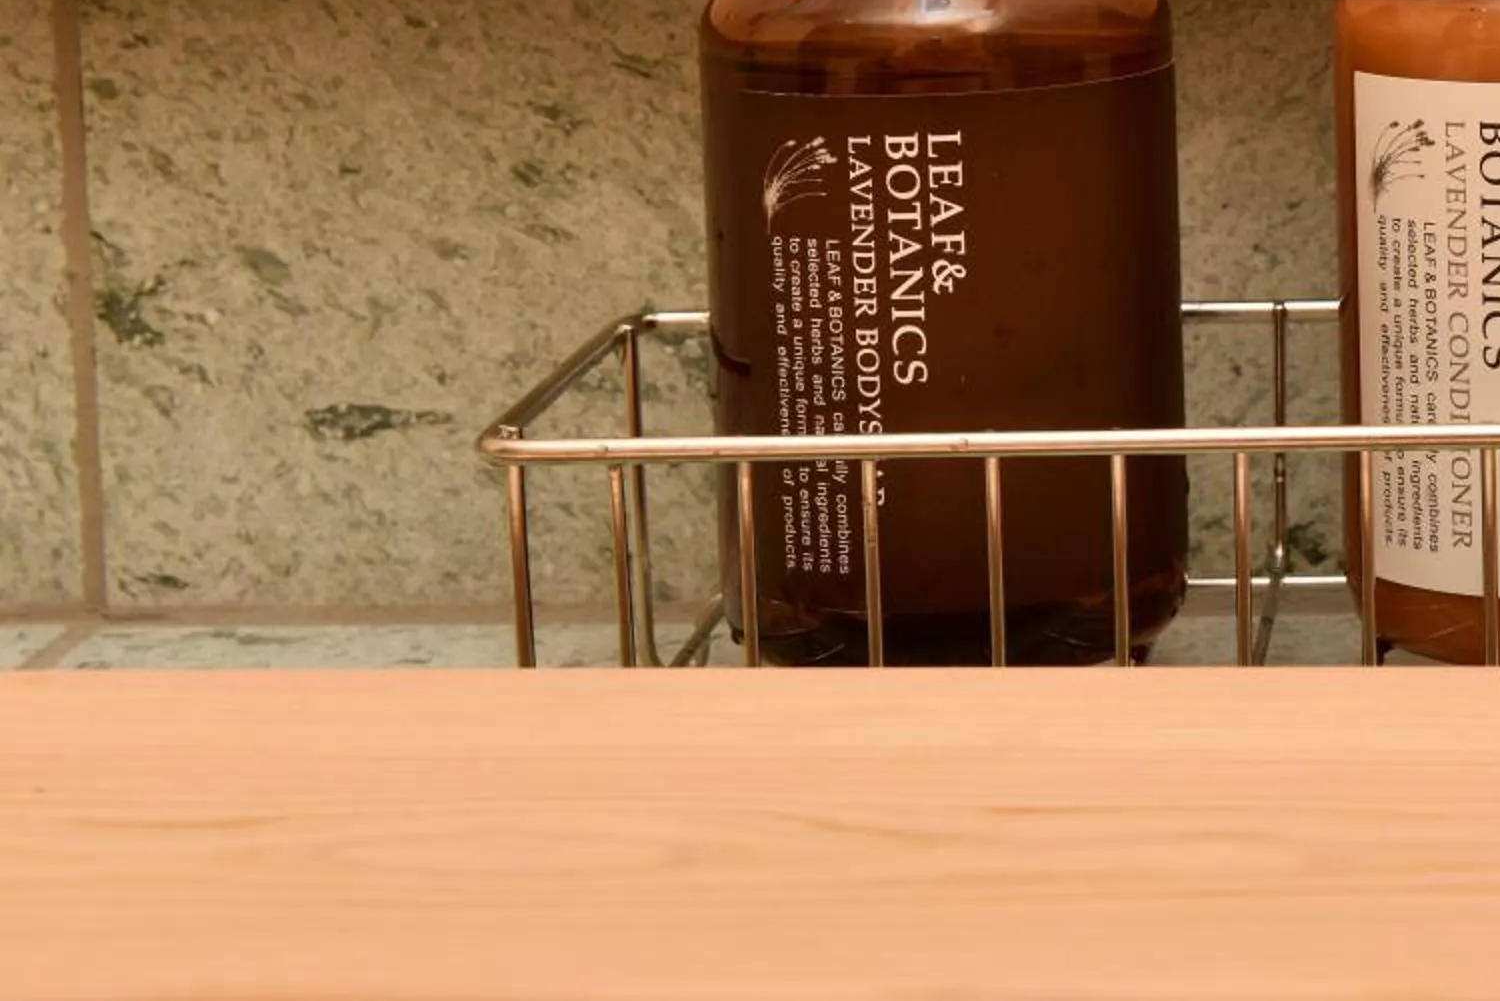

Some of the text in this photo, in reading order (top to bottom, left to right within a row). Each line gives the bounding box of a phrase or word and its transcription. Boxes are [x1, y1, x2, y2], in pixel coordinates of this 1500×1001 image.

[927, 130, 966, 294] LEAF&
[1392, 218, 1402, 233] to
[771, 236, 785, 292] quality
[789, 238, 801, 253] to
[825, 239, 841, 286] LEAF
[884, 132, 928, 385] BOTANICS
[1377, 214, 1389, 271] quality
[1393, 240, 1402, 292] create
[1407, 219, 1418, 289] selected
[1423, 222, 1437, 267] LEAF
[790, 260, 803, 311] create
[807, 238, 822, 308] selected
[828, 290, 842, 302] &
[1380, 282, 1390, 312] and
[1424, 272, 1437, 283] &
[775, 303, 787, 335] and
[793, 319, 803, 328] a
[847, 135, 885, 506] LAVENDER BODYS
[1394, 298, 1402, 307] a
[1408, 298, 1419, 344] herbs
[811, 318, 824, 364] herbs
[828, 306, 845, 401] BOTANICS
[1393, 314, 1403, 369] unique
[1425, 289, 1438, 382] BOTANICS
[1445, 121, 1473, 548] LAVENDER CONDIIONER
[789, 336, 807, 392] unique
[812, 374, 826, 406] and
[1410, 354, 1421, 384] and
[782, 469, 794, 485] of
[799, 467, 811, 482] to
[1397, 466, 1406, 521] ensure
[799, 488, 812, 545] ensure
[815, 482, 831, 572] ingredients
[1410, 460, 1424, 549] ingredients
[1428, 473, 1441, 552] combines
[836, 494, 851, 574] combines
[802, 553, 814, 571] its
